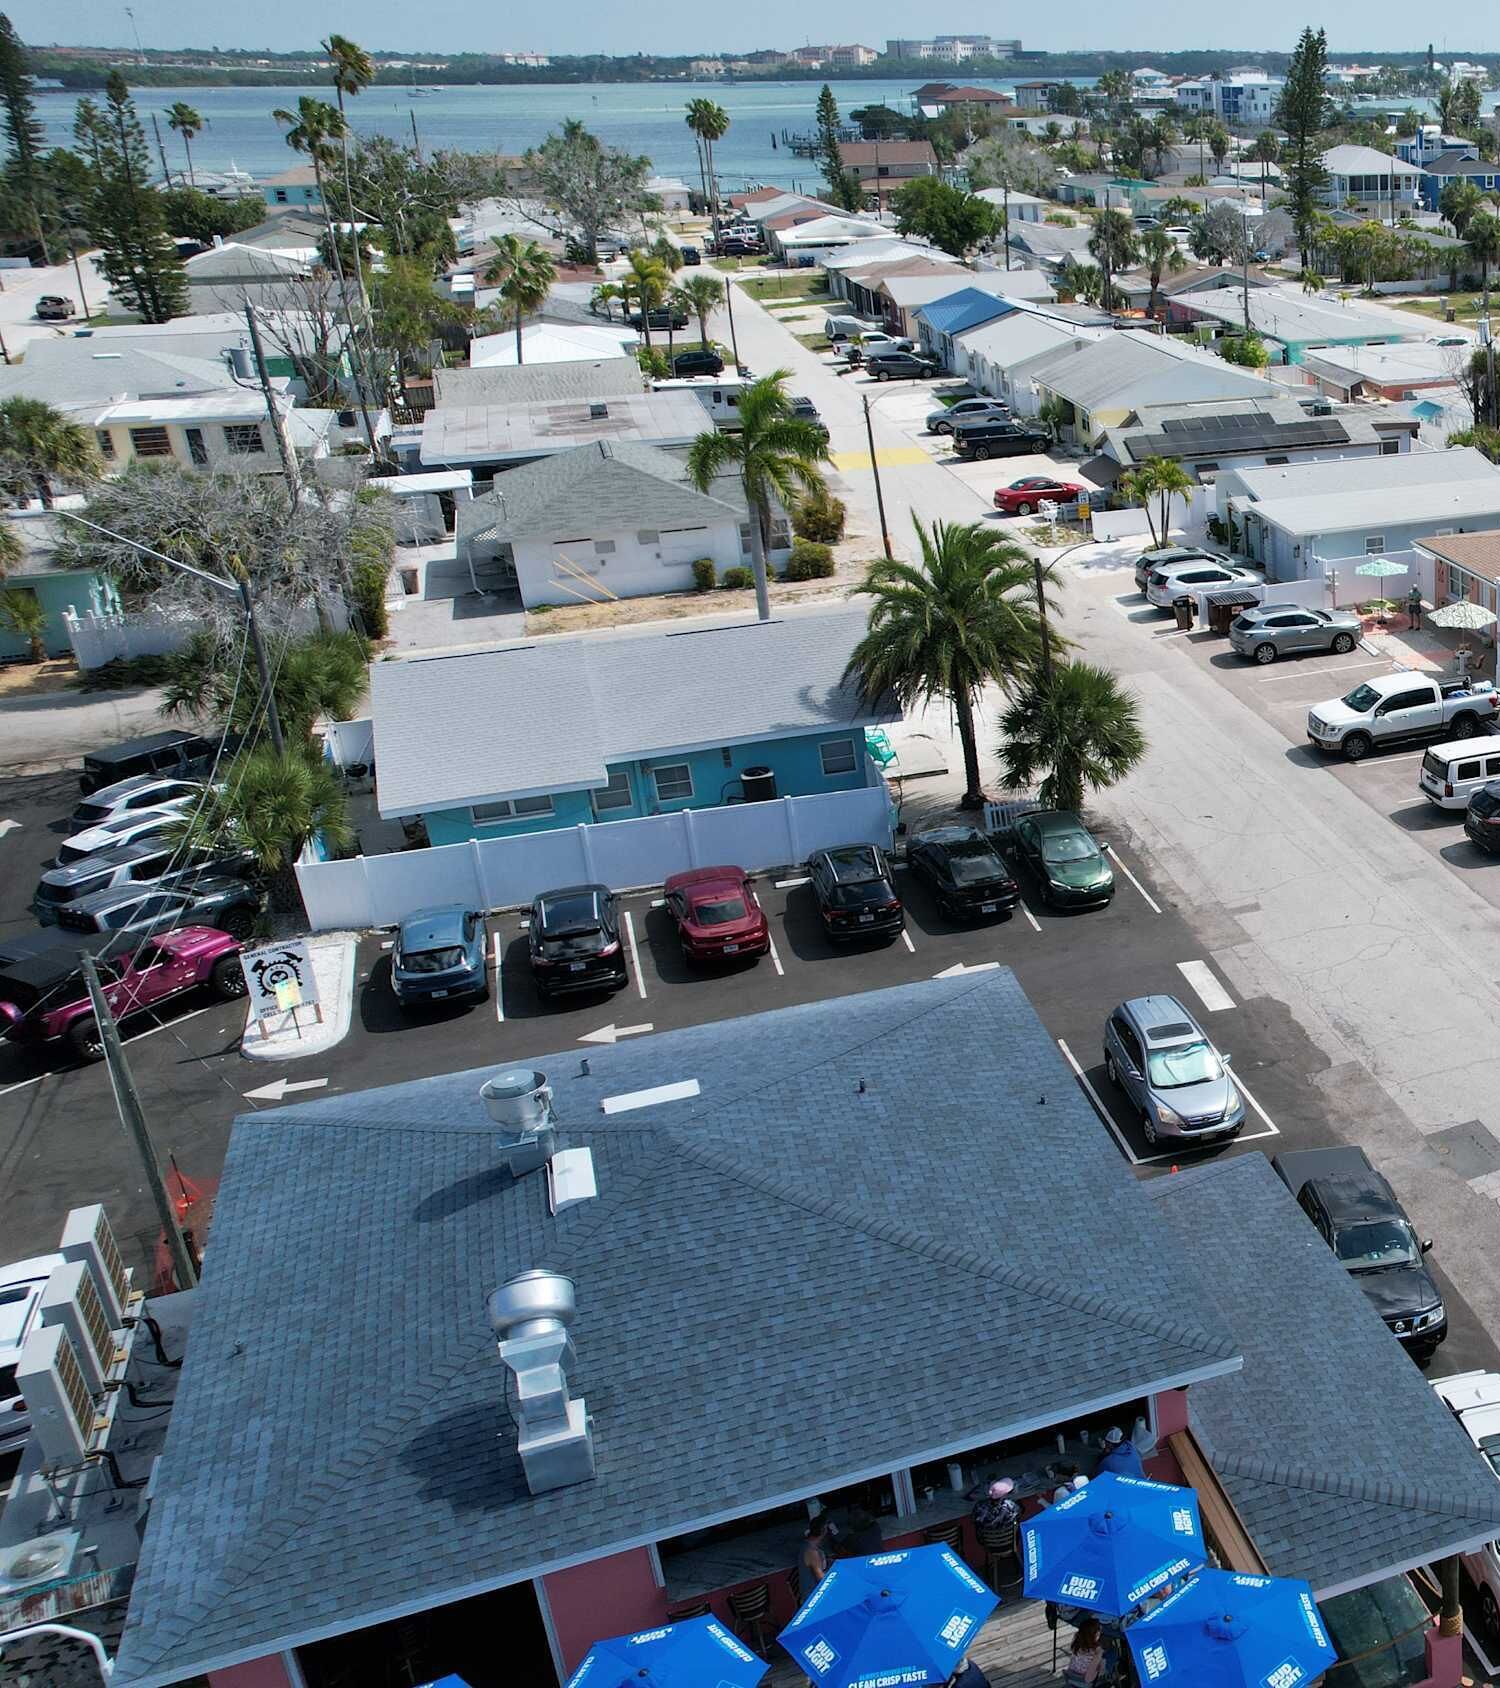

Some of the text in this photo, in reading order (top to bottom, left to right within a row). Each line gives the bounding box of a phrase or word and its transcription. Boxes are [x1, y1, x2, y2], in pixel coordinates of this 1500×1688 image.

[243, 941, 302, 960] GENERAL CONTRACTOR
[1060, 1584, 1098, 1600] LIGHT
[1069, 1576, 1097, 1590] BUD
[1128, 1582, 1152, 1602] CLEAN
[1149, 1571, 1169, 1588] CRISP
[1168, 1558, 1190, 1577] TASTE
[940, 1615, 962, 1640] BUD
[946, 1615, 973, 1649] LIGHT
[804, 1645, 831, 1673] LIGHT
[814, 1640, 835, 1662] BUD
[1153, 1645, 1167, 1672] BUD
[1143, 1647, 1160, 1680] LIGHT
[1266, 1663, 1293, 1687] BUD
[848, 1677, 876, 1688] CLEAN
[876, 1674, 901, 1688] CRISP
[901, 1669, 927, 1683] TASTE
